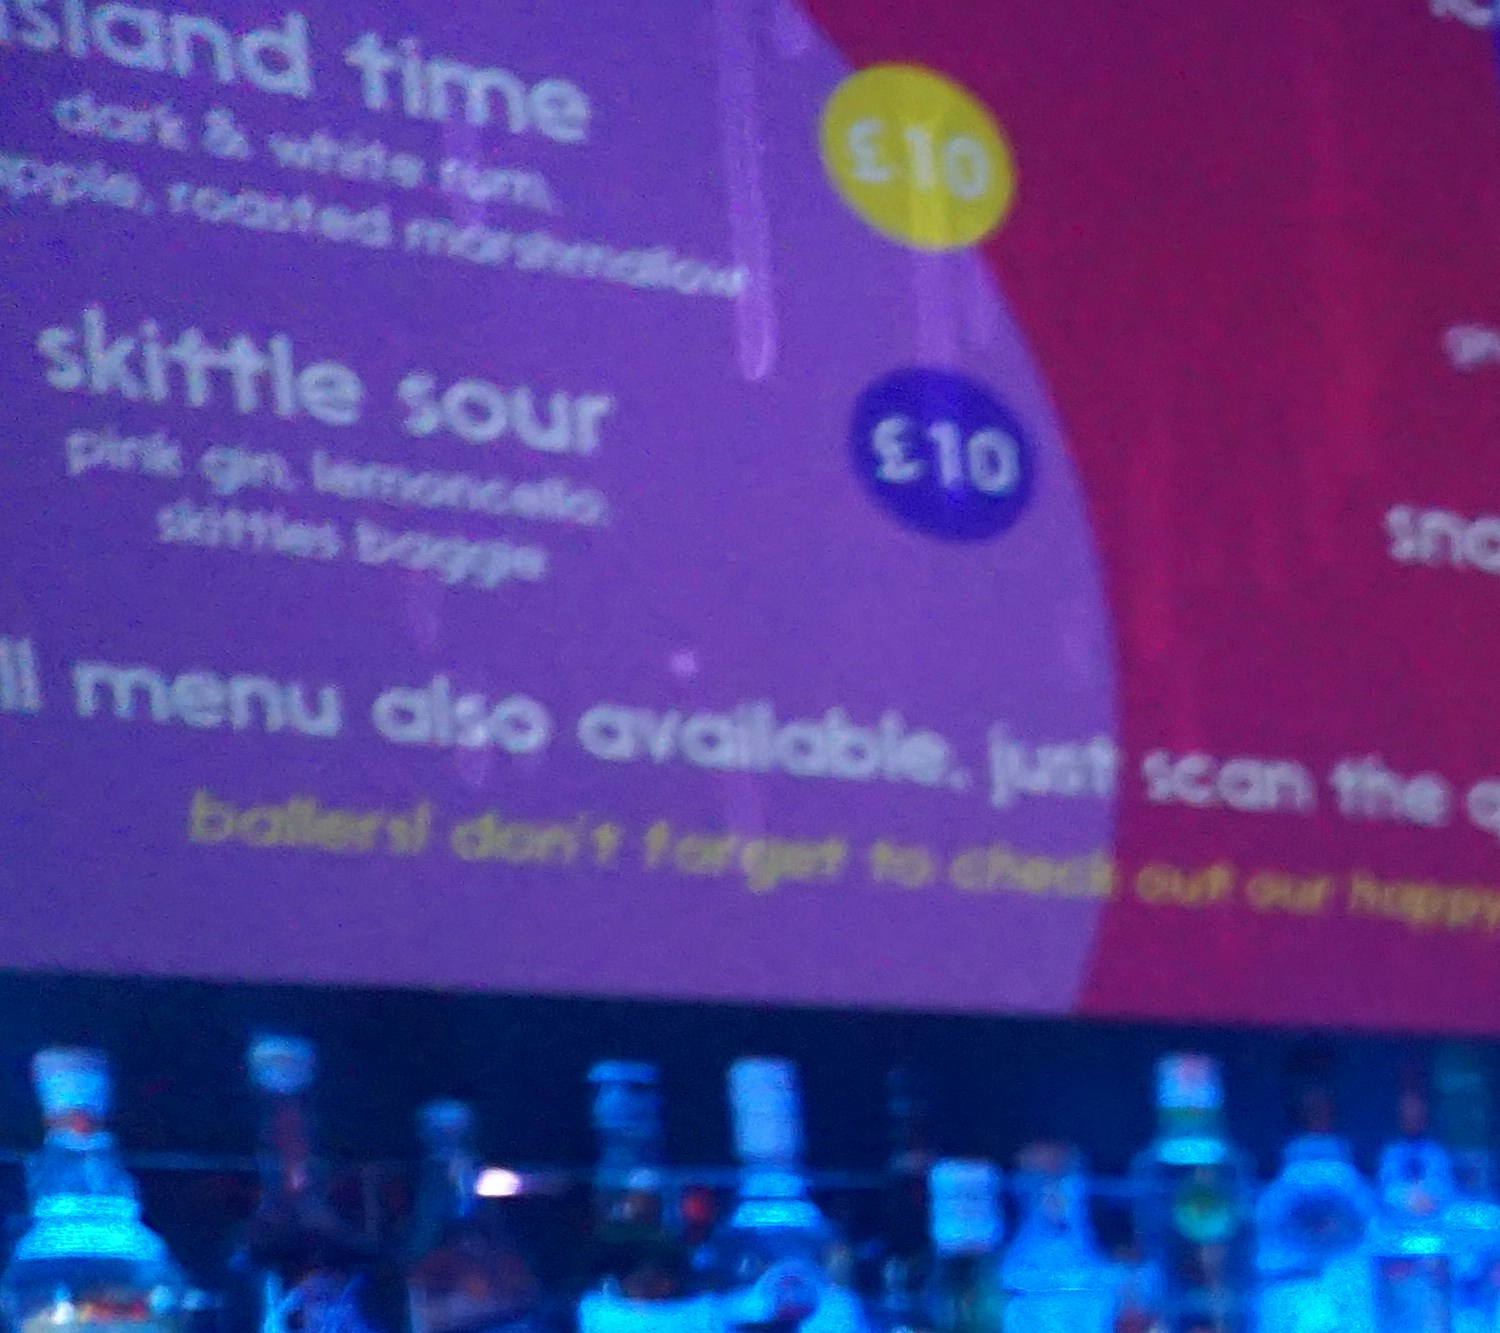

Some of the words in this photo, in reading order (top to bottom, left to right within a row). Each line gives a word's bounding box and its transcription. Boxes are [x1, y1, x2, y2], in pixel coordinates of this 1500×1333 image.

[54, 91, 188, 149] dark
[344, 33, 592, 143] time
[847, 117, 993, 199] £10
[0, 153, 155, 214] pple,
[168, 181, 393, 248] roasted
[405, 217, 748, 298] marshmallow
[37, 307, 364, 426] skittle
[398, 370, 614, 455] sour
[66, 427, 183, 476] pink
[871, 413, 1021, 497] £10
[157, 497, 344, 561] skittles
[74, 659, 344, 738] menu
[371, 674, 553, 755] also
[987, 717, 1120, 811] just
[1141, 747, 1316, 813] scan
[1329, 754, 1451, 828] the
[450, 810, 624, 868] don't
[645, 819, 849, 895] forget
[867, 838, 934, 889] to
[949, 842, 1117, 899] check
[1136, 861, 1235, 905] out
[1245, 870, 1335, 916] our
